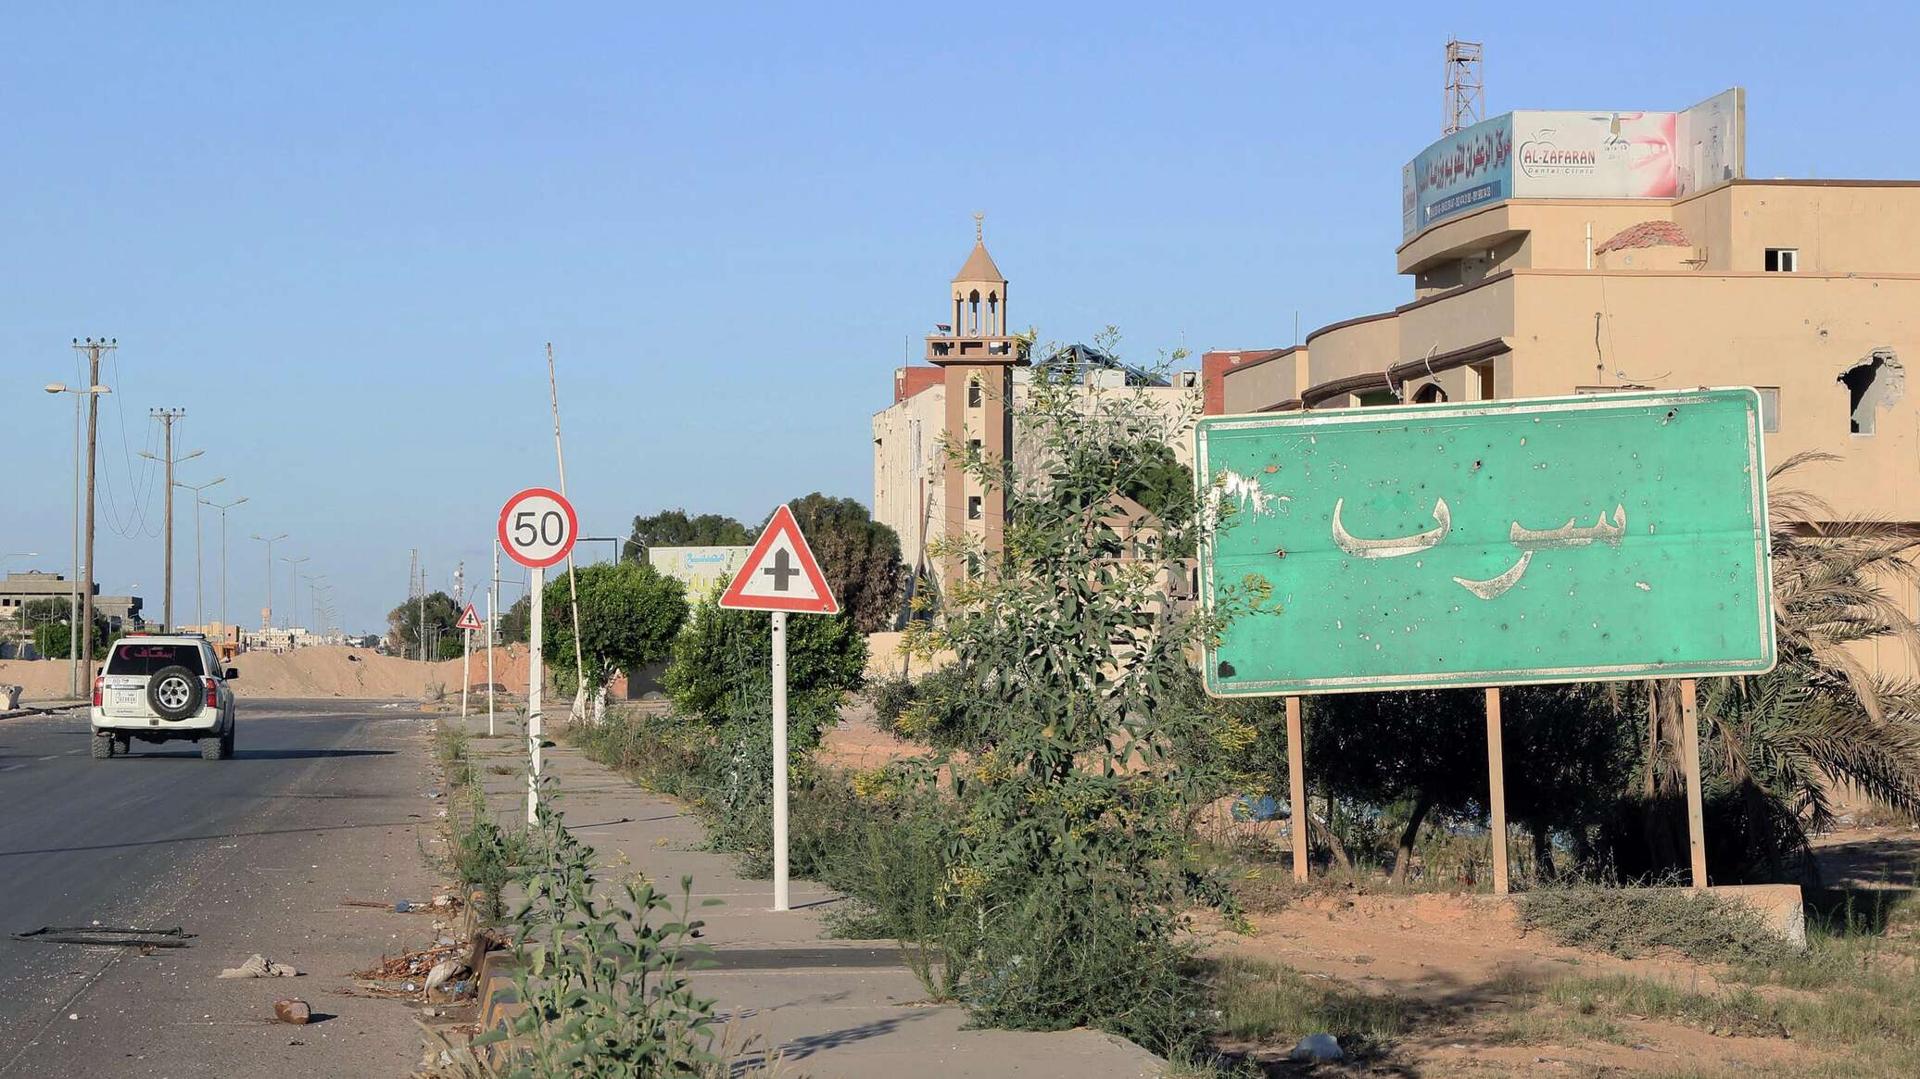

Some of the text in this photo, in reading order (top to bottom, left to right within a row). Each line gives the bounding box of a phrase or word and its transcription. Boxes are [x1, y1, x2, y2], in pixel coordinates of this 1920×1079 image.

[1524, 150, 1596, 165] AL-ZAFARAN
[1528, 167, 1595, 175] Dental Clinic
[514, 511, 564, 547] 50
